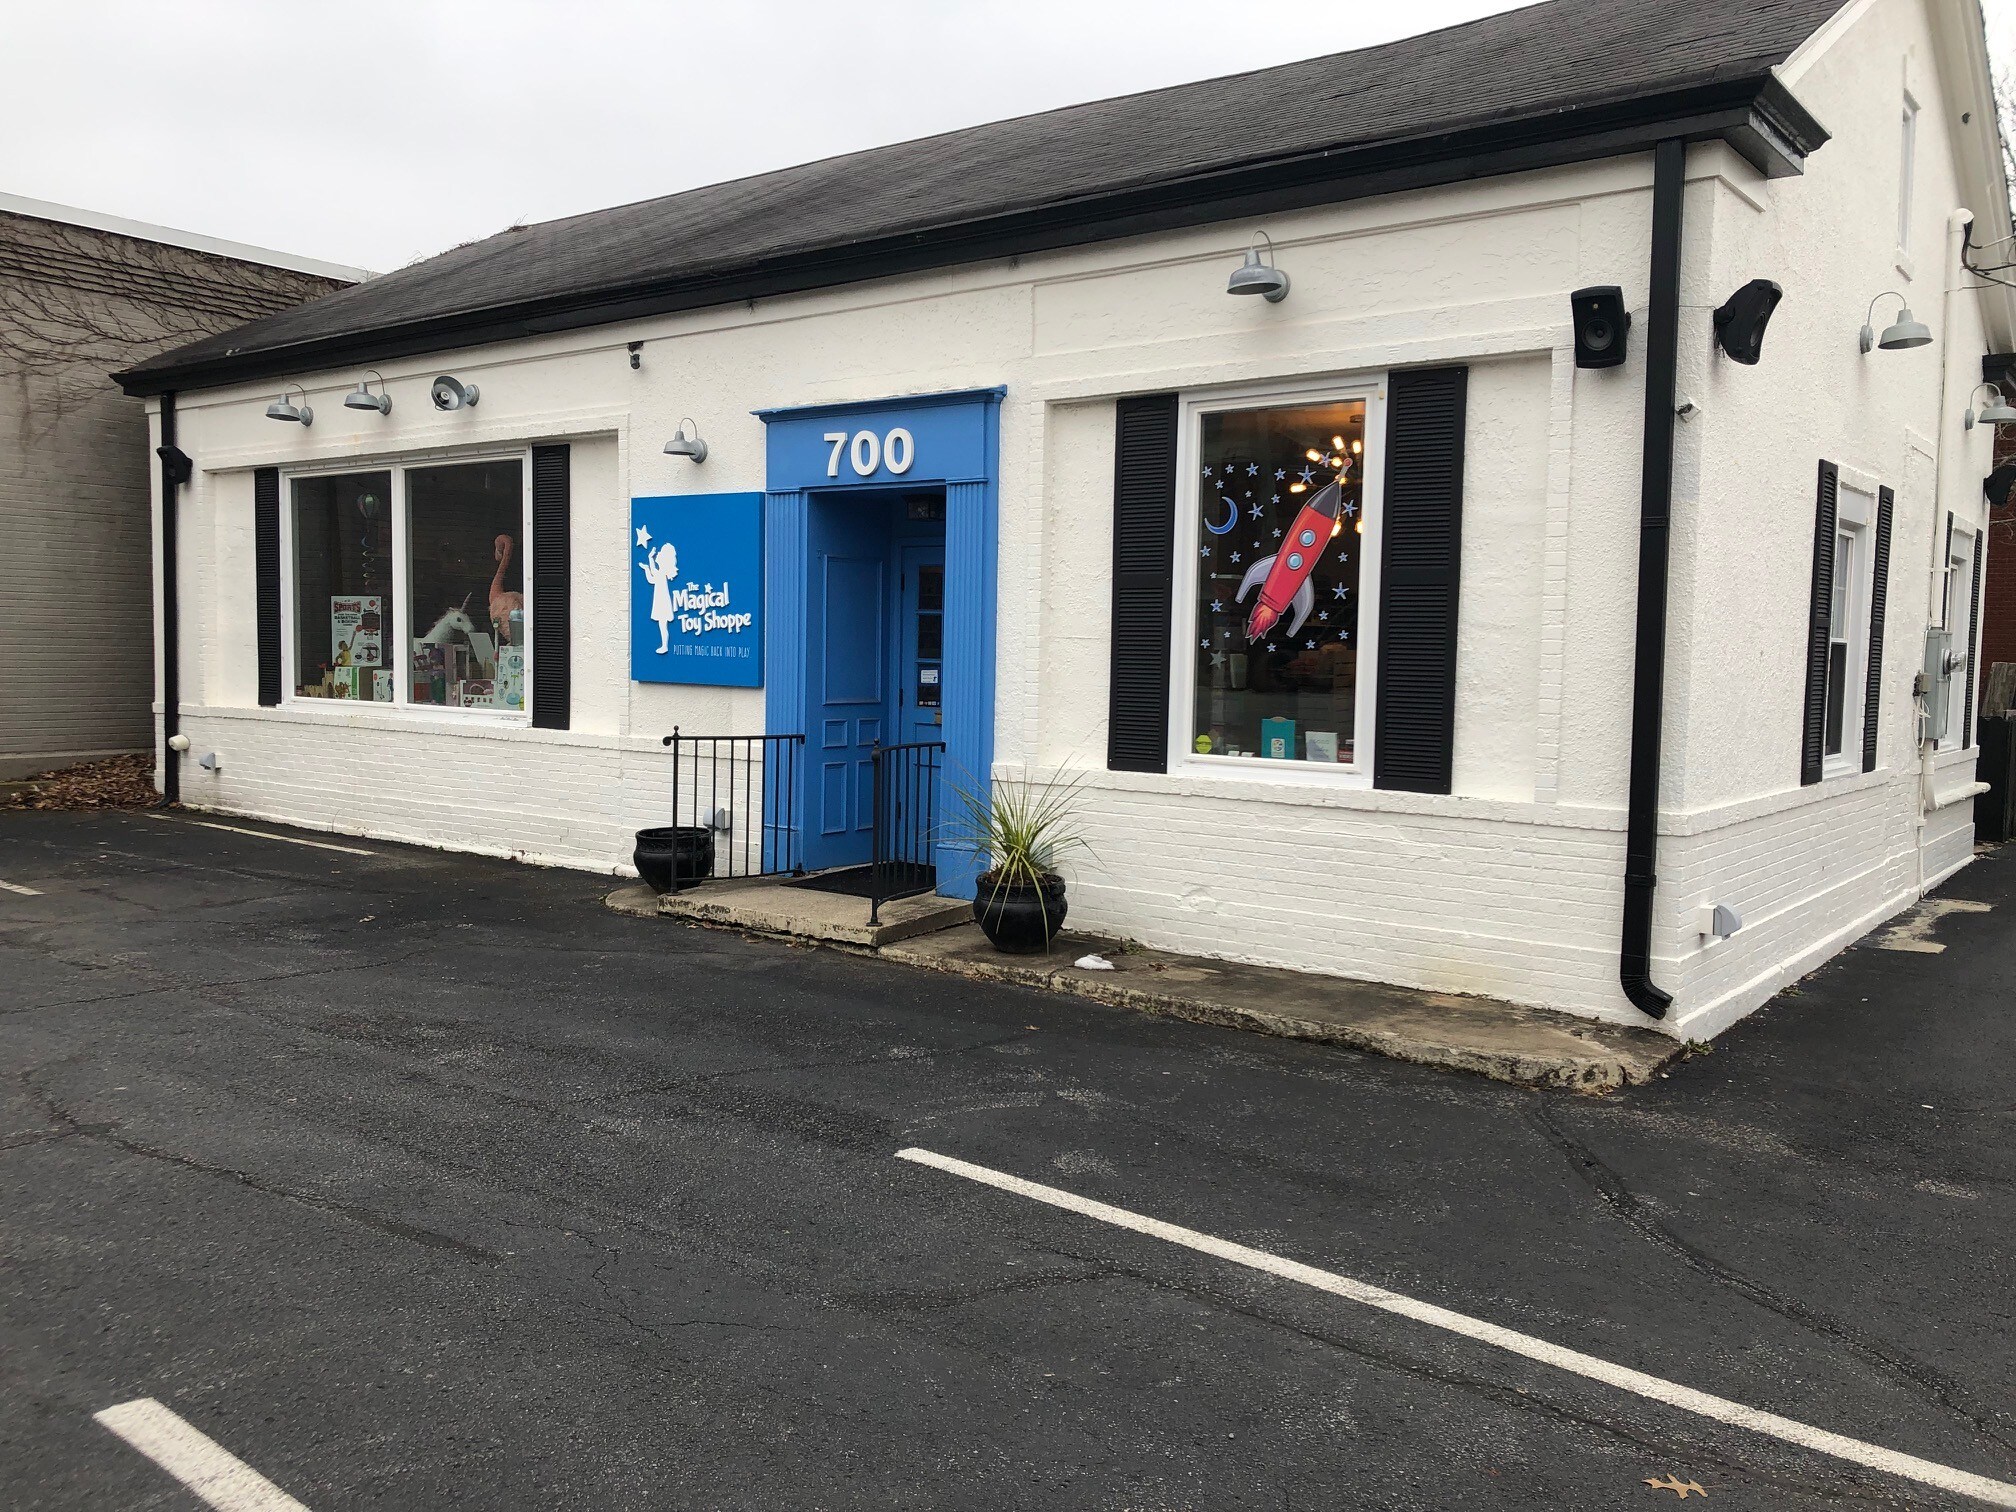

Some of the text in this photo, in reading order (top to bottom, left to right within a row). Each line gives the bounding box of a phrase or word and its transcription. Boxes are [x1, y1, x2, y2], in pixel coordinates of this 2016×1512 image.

[824, 428, 915, 476] 700
[673, 582, 730, 615] Magical
[686, 582, 699, 591] The
[678, 610, 752, 636] Toy Shoppe
[673, 645, 693, 656] PUTTING
[694, 645, 710, 656] MAGIC
[710, 645, 723, 657] BACK
[724, 646, 737, 657] INTO
